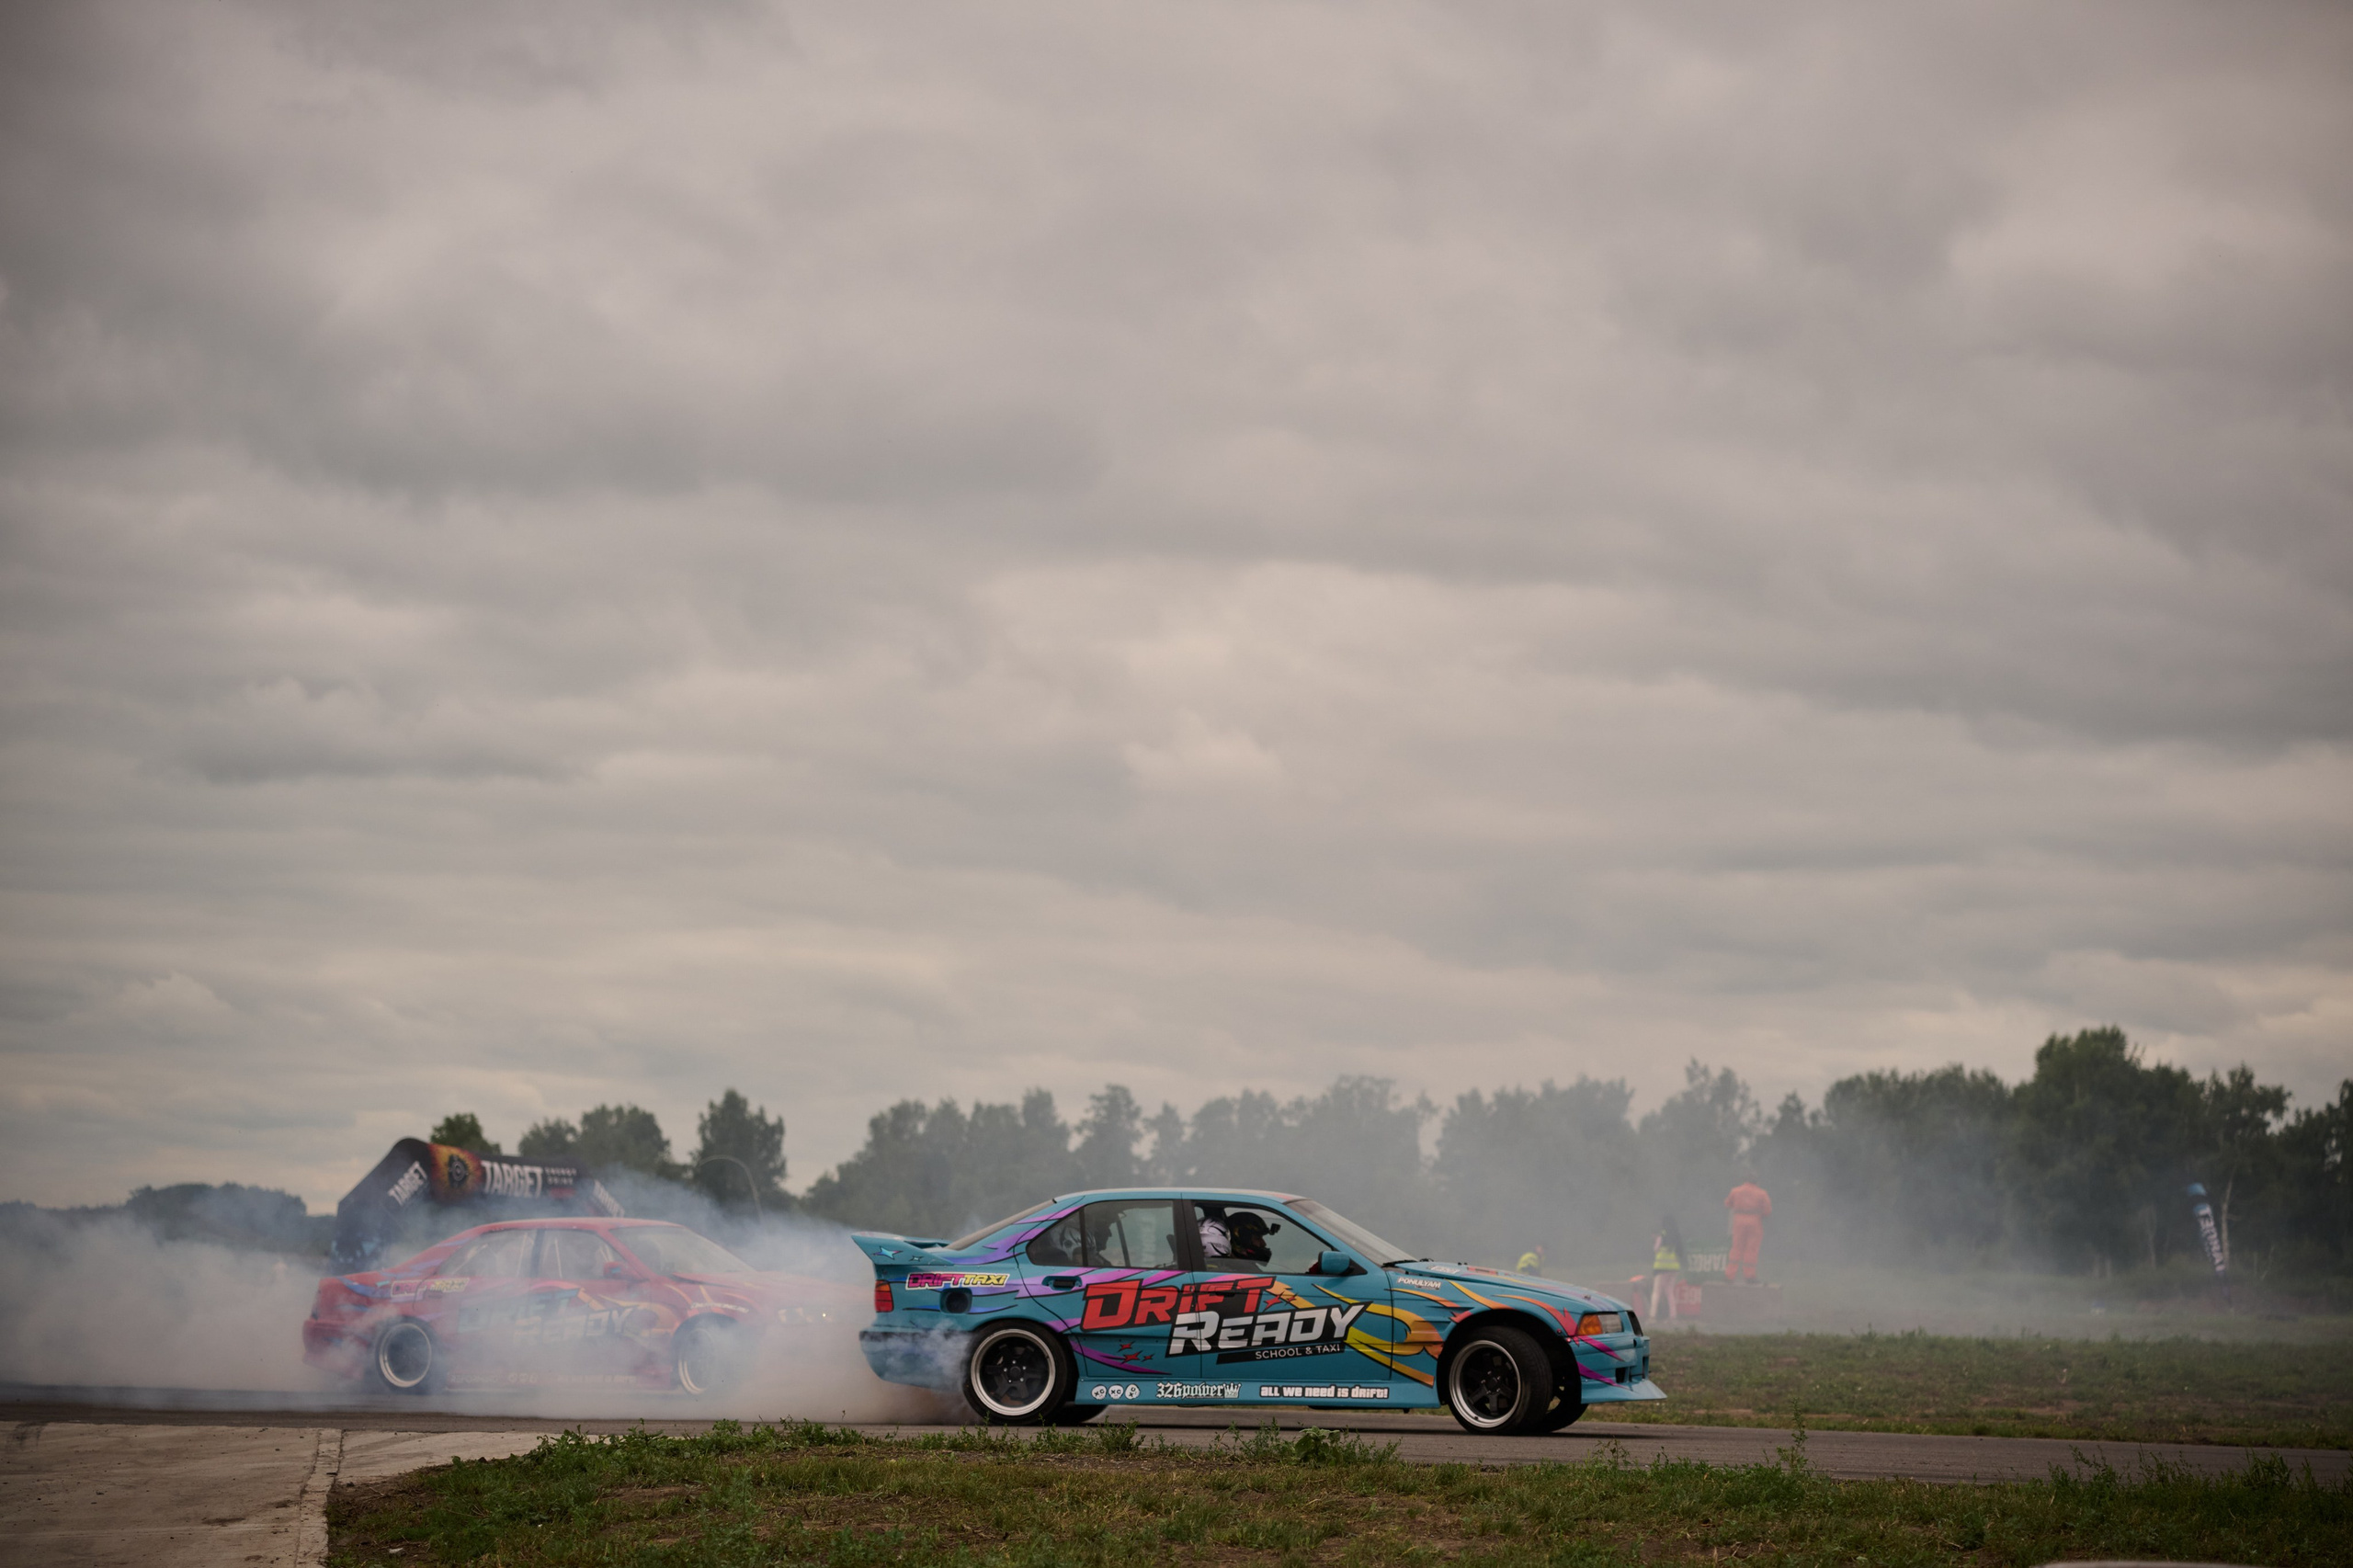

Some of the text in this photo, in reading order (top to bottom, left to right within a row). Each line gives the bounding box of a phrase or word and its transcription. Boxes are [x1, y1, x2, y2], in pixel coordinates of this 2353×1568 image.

[388, 1161, 427, 1206] TARGET
[481, 1161, 544, 1199] TARGET
[1081, 1276, 1277, 1331] DRIFT
[1168, 1303, 1367, 1356] READY
[1255, 1344, 1341, 1360] SCHOOL & TAXI
[1282, 1386, 1303, 1397] we
[1305, 1385, 1336, 1397] need
[1337, 1387, 1348, 1397] is
